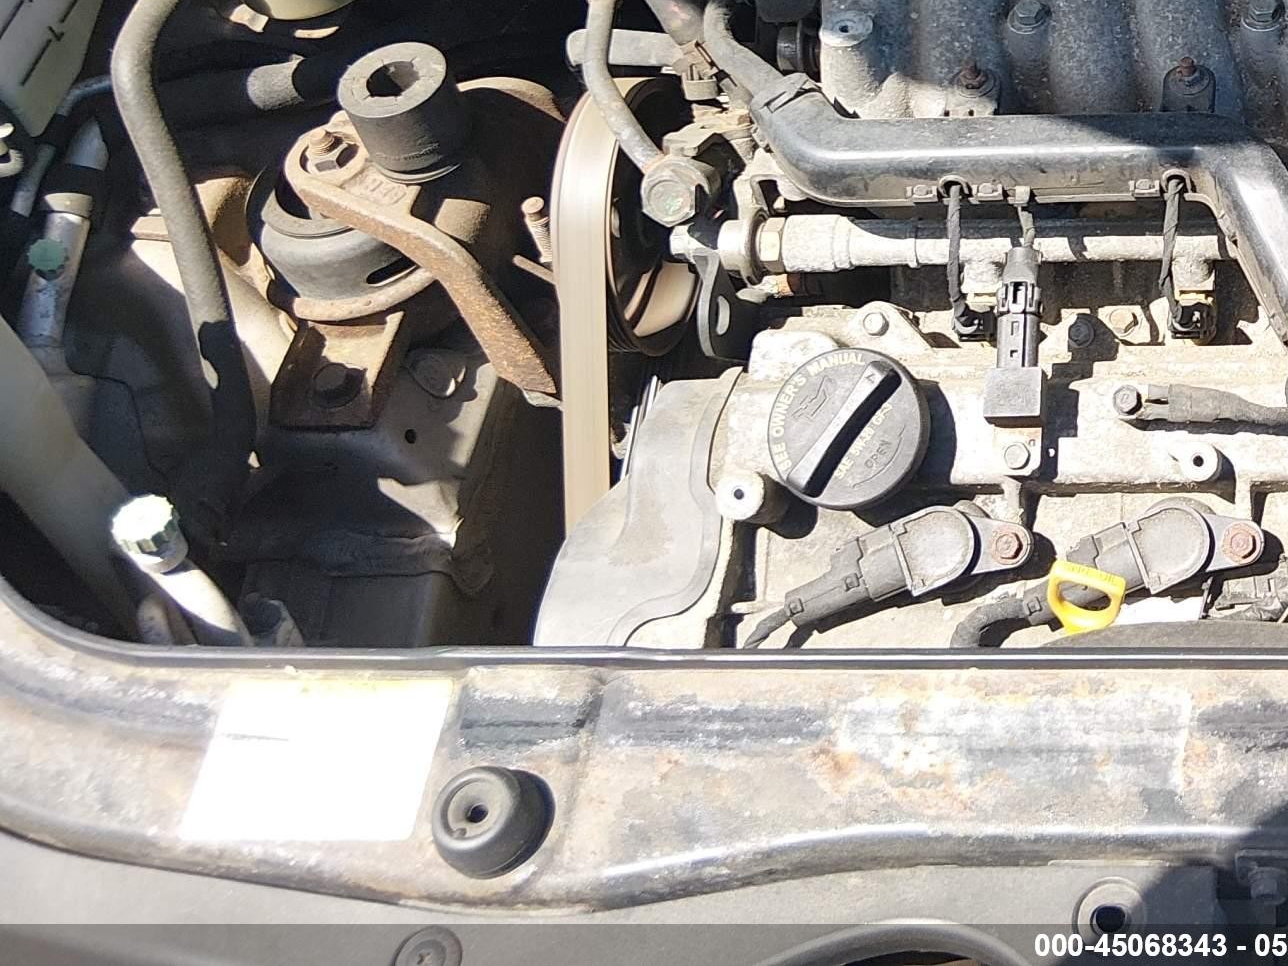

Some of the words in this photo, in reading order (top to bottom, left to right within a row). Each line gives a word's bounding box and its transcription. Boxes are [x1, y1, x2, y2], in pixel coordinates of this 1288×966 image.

[807, 352, 865, 375] MANUAL
[773, 375, 806, 437] OWNER'S
[773, 442, 792, 470] SEE
[865, 440, 891, 468] OPEN
